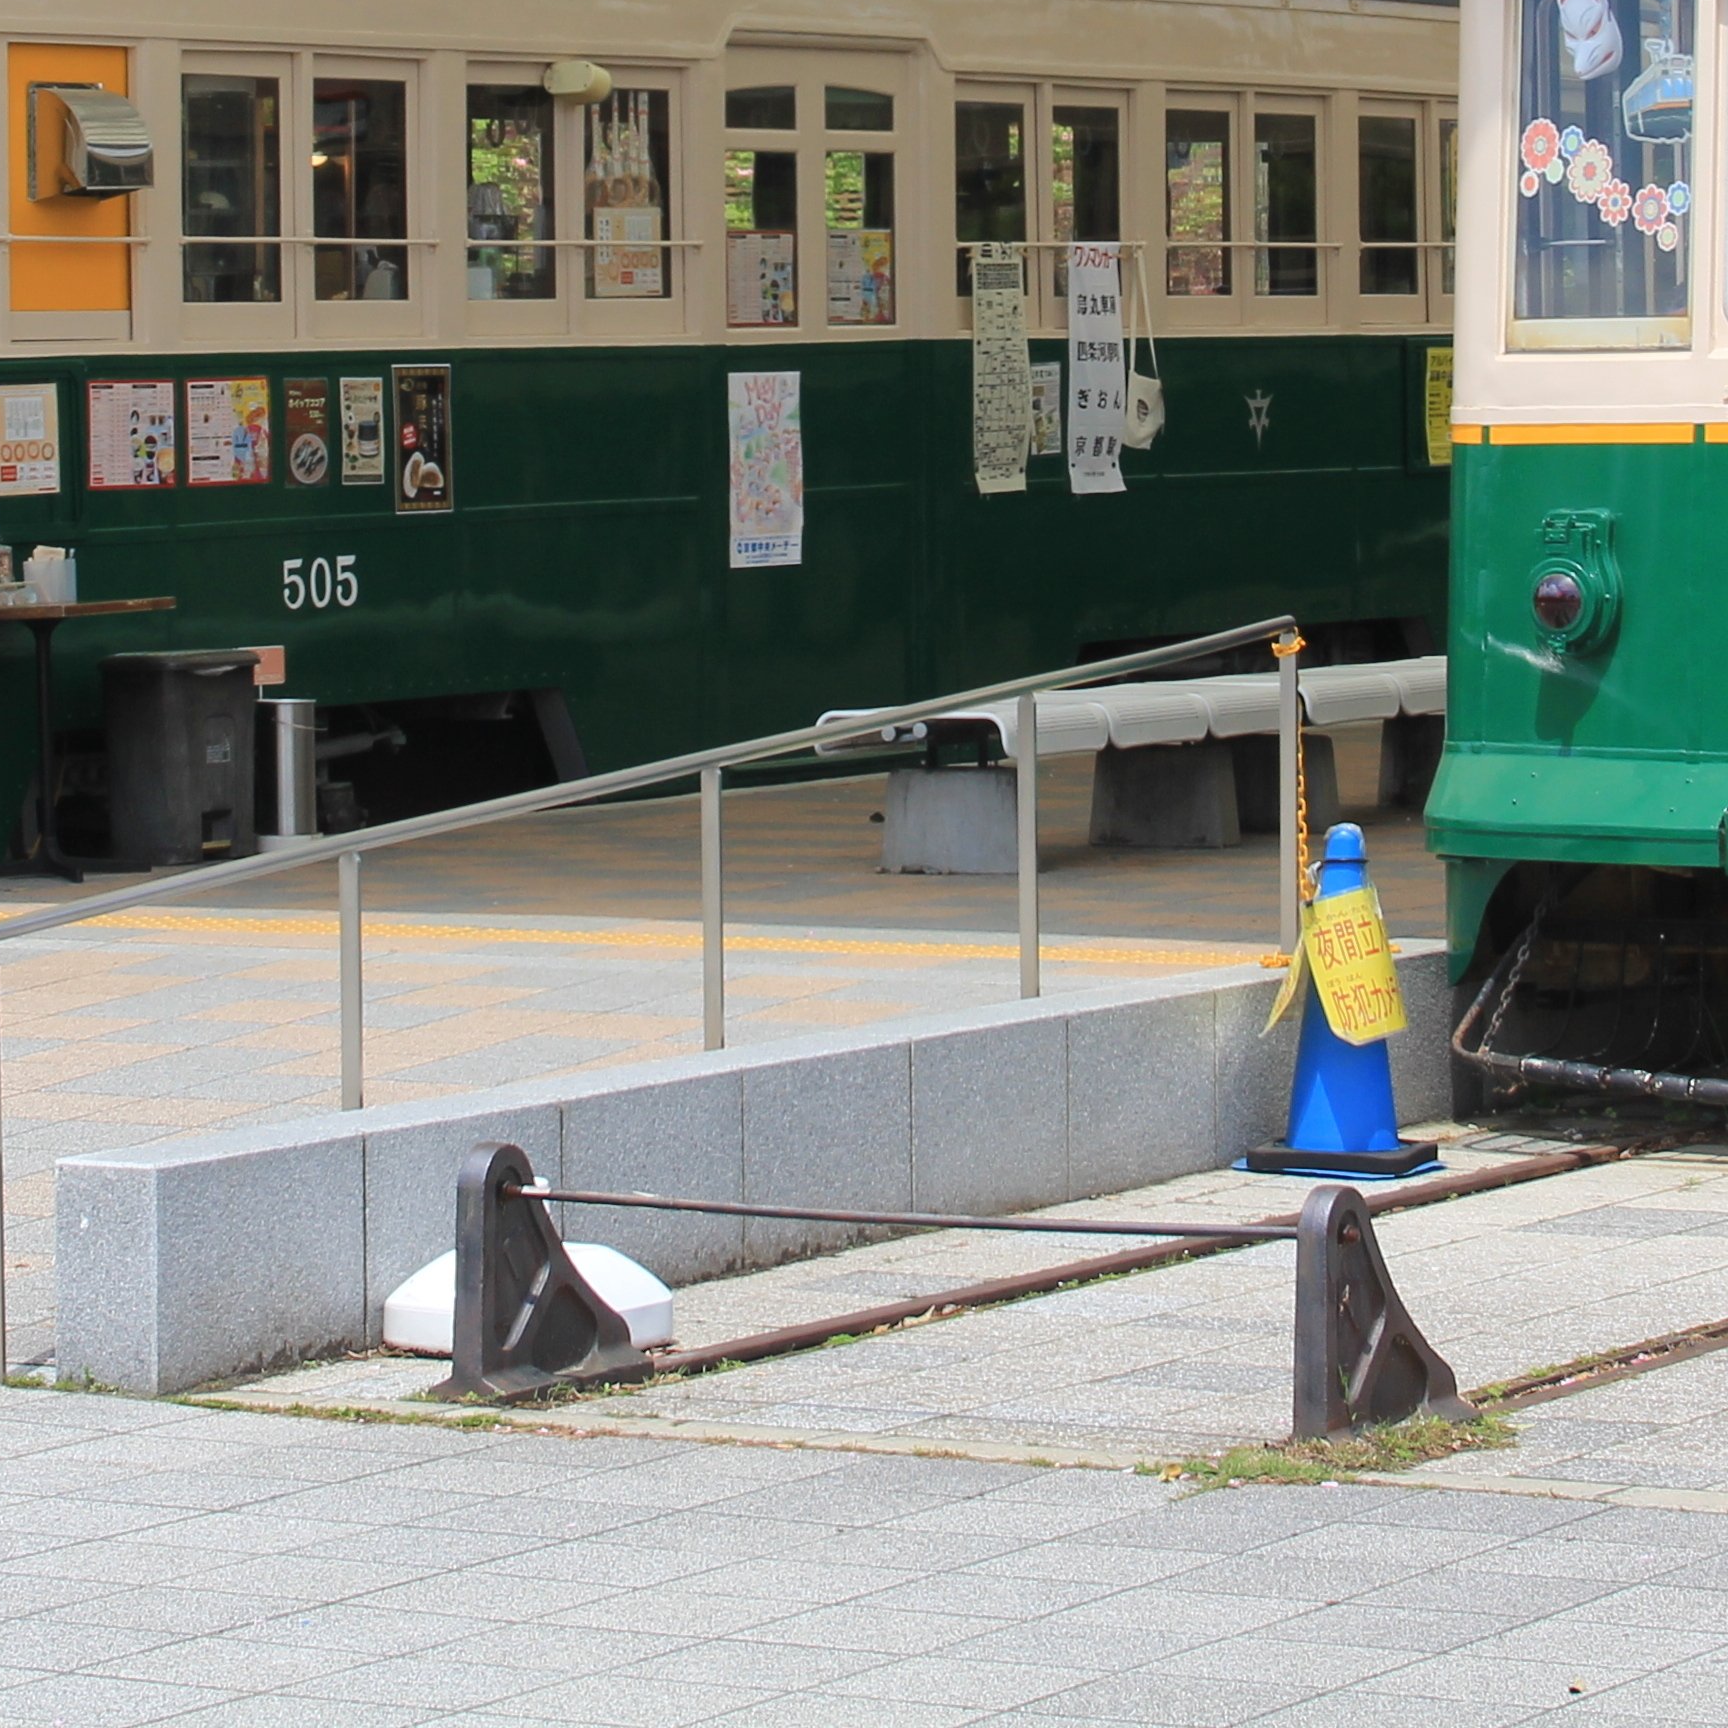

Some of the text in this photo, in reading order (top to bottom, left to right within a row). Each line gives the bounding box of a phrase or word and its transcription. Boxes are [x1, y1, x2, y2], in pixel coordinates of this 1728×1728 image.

[1077, 388, 1121, 410] ぎおん
[282, 554, 359, 610] 505
